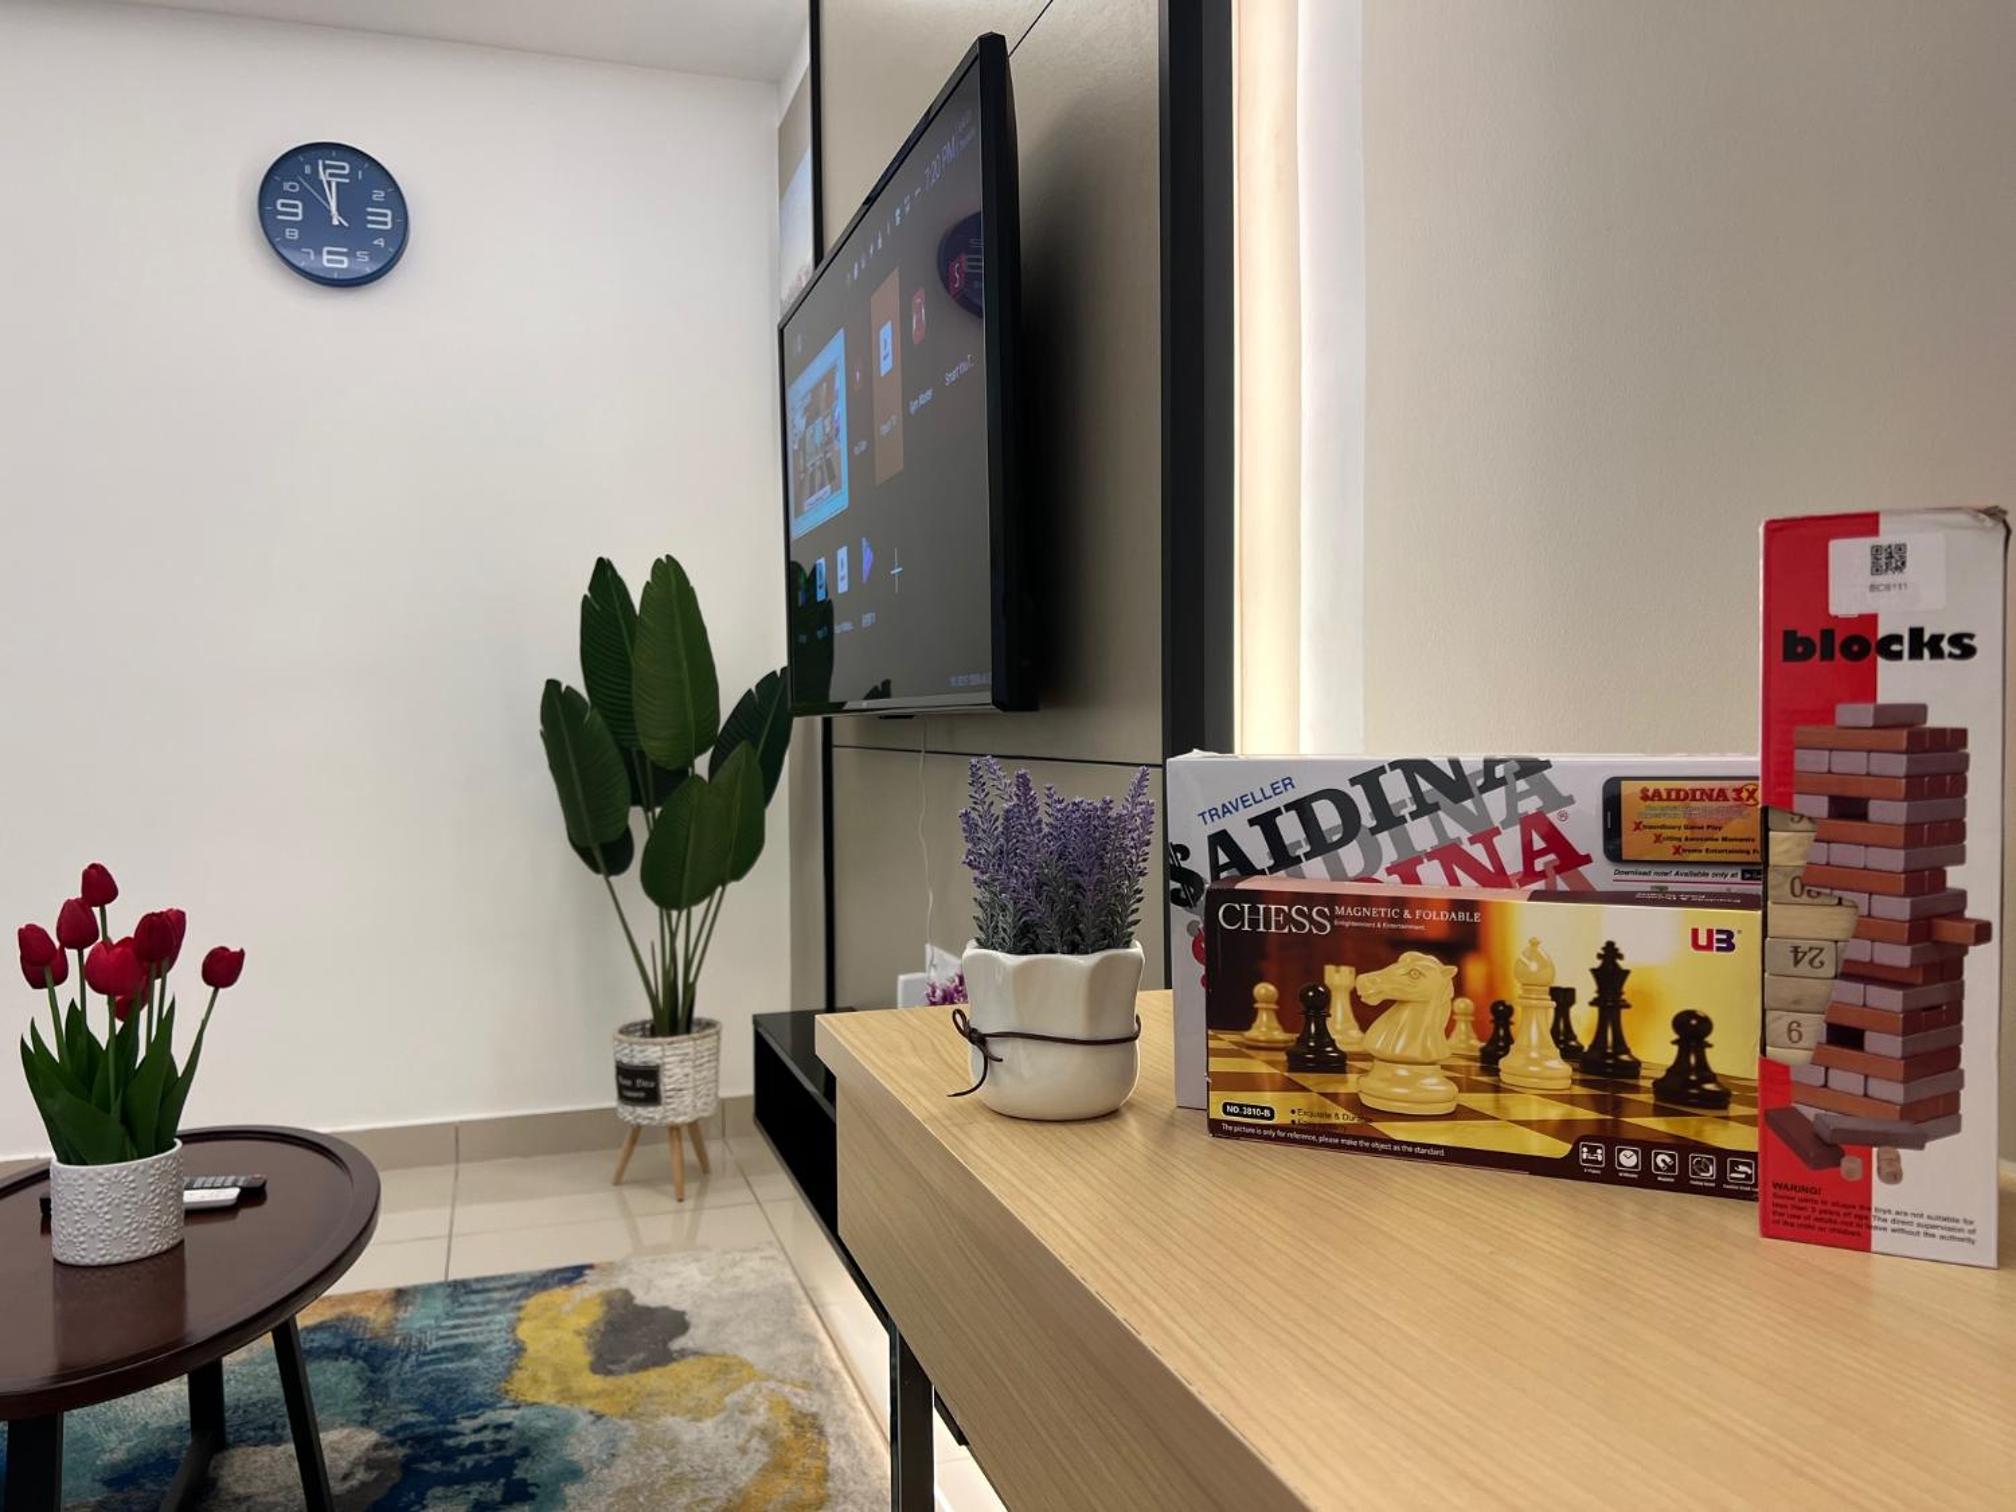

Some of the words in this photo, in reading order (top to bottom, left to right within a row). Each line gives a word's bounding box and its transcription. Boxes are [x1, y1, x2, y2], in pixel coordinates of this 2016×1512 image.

[372, 190, 385, 201] 2
[276, 199, 302, 221] 9
[366, 207, 392, 229] 3
[285, 228, 299, 240] 8
[372, 238, 385, 248] 4
[302, 249, 314, 260] 7
[322, 246, 348, 268] 6
[356, 251, 370, 262] 5
[1782, 626, 1978, 663] blocks
[1198, 776, 1296, 826] TRAVELLER
[1613, 868, 1652, 876] Download
[1674, 870, 1709, 878] Available
[1711, 871, 1728, 880] only
[1218, 902, 1332, 935] CHESS
[1334, 906, 1400, 919] MAGNETIC
[1403, 909, 1412, 919] &
[1415, 909, 1481, 923] FOLDABLE
[1789, 945, 1826, 969] 24
[1221, 1123, 1232, 1131] The
[1234, 1125, 1255, 1135] picture
[1263, 1128, 1275, 1137] only
[1277, 1129, 1286, 1137] for
[1318, 1134, 1339, 1144] please
[1359, 1139, 1369, 1147] the
[1371, 1141, 1391, 1151] object
